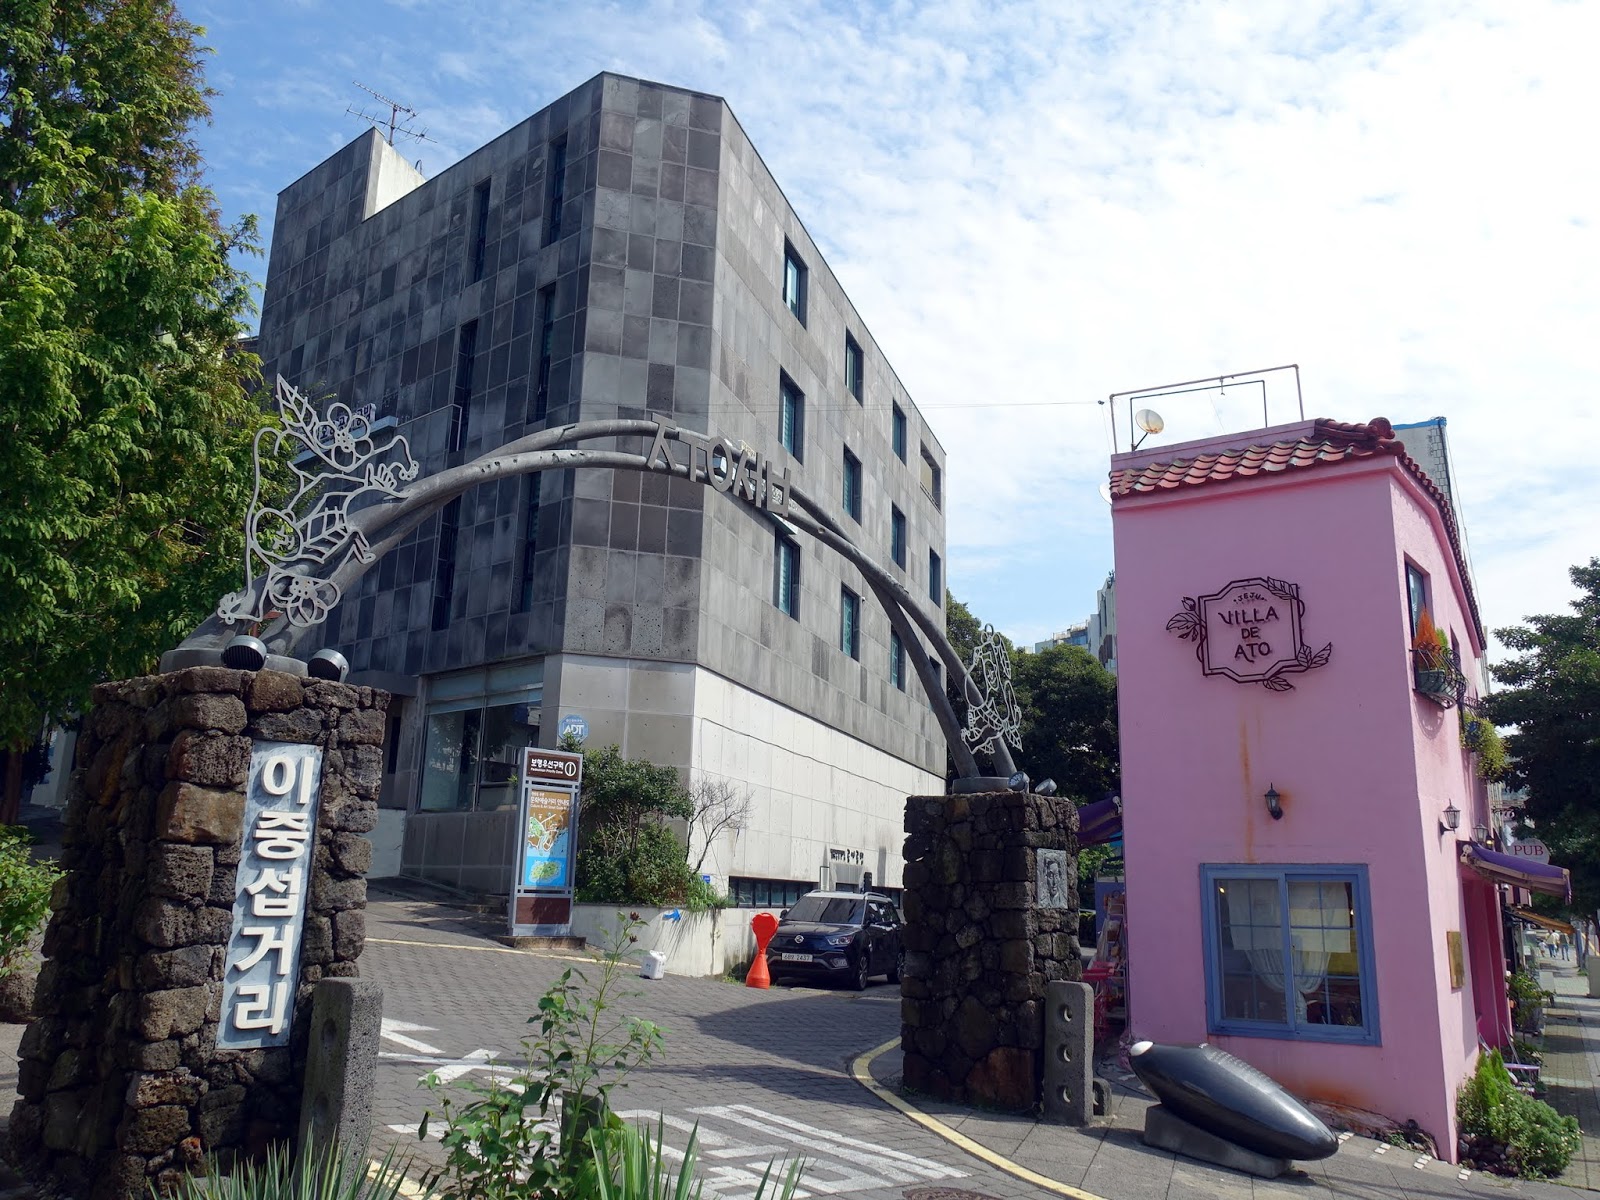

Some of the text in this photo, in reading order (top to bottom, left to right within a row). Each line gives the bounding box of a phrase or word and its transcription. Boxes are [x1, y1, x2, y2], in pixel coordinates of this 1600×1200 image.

[1218, 606, 1279, 625] VILLA
[1241, 627, 1260, 639] DE
[1234, 642, 1271, 663] ATO
[563, 724, 585, 735] ADT
[531, 758, 564, 770] 보행우선구역
[1514, 845, 1544, 856] PUB
[233, 755, 315, 1035] 이중섭거리
